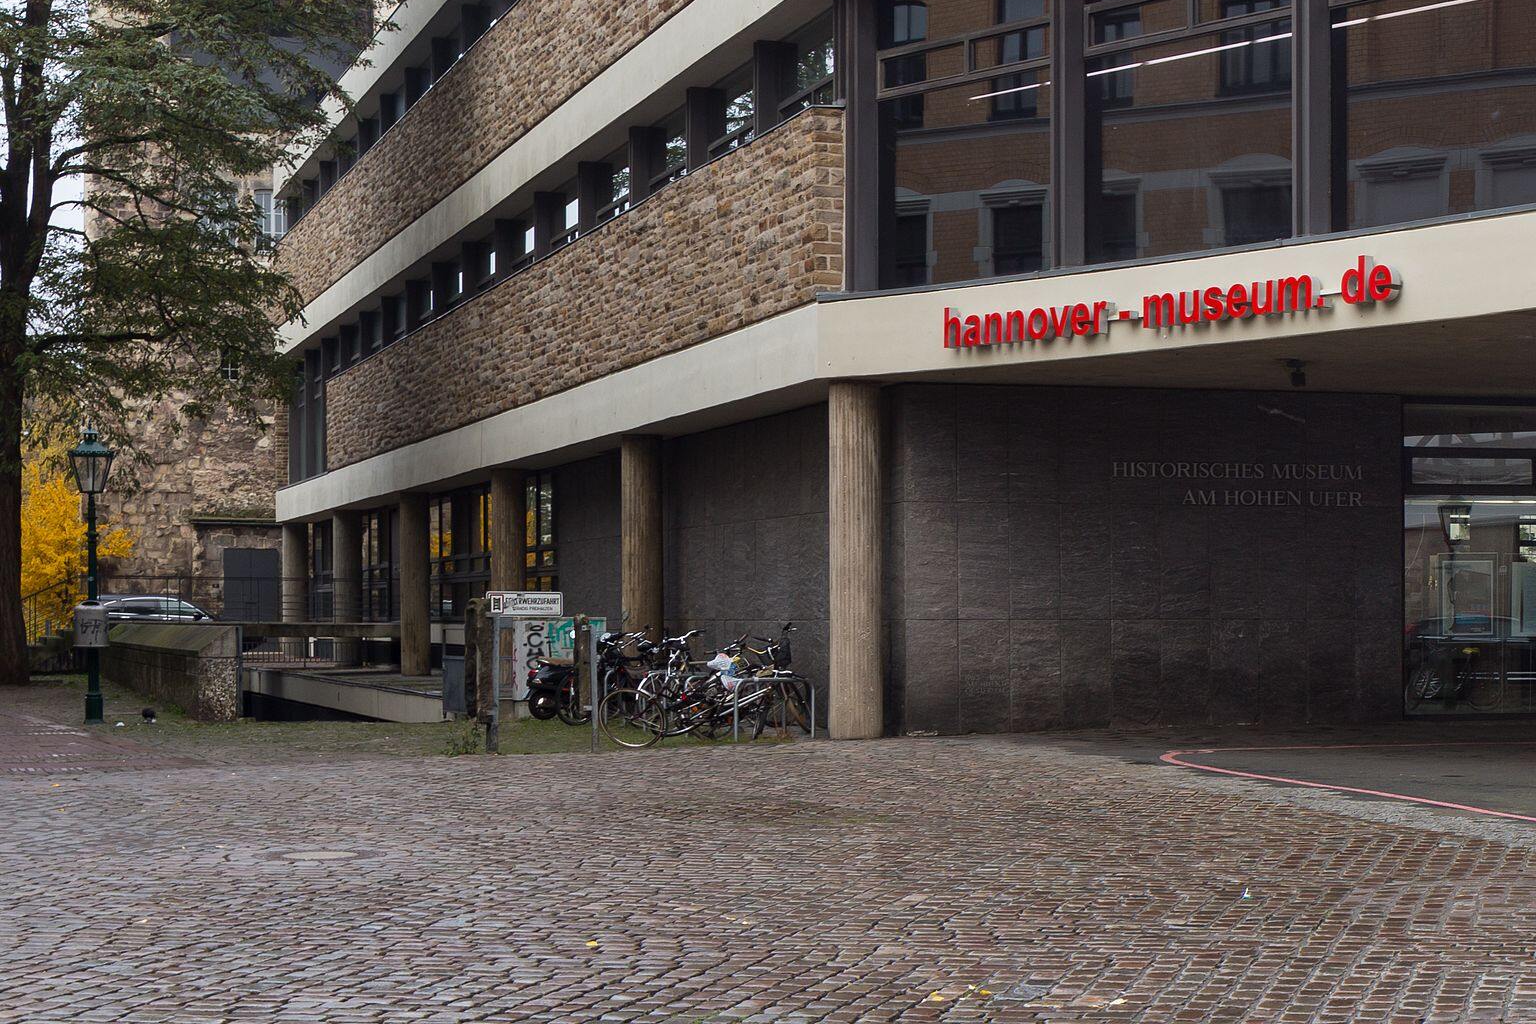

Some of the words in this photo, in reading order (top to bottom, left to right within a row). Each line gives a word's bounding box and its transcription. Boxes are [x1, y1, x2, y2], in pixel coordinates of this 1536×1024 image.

[1112, 461, 1265, 479] HISTORISCHES
[1271, 462, 1363, 480] MUSEUM
[1182, 489, 1216, 505] AM
[1224, 489, 1302, 506] HOHEN
[1309, 491, 1363, 507] UFER
